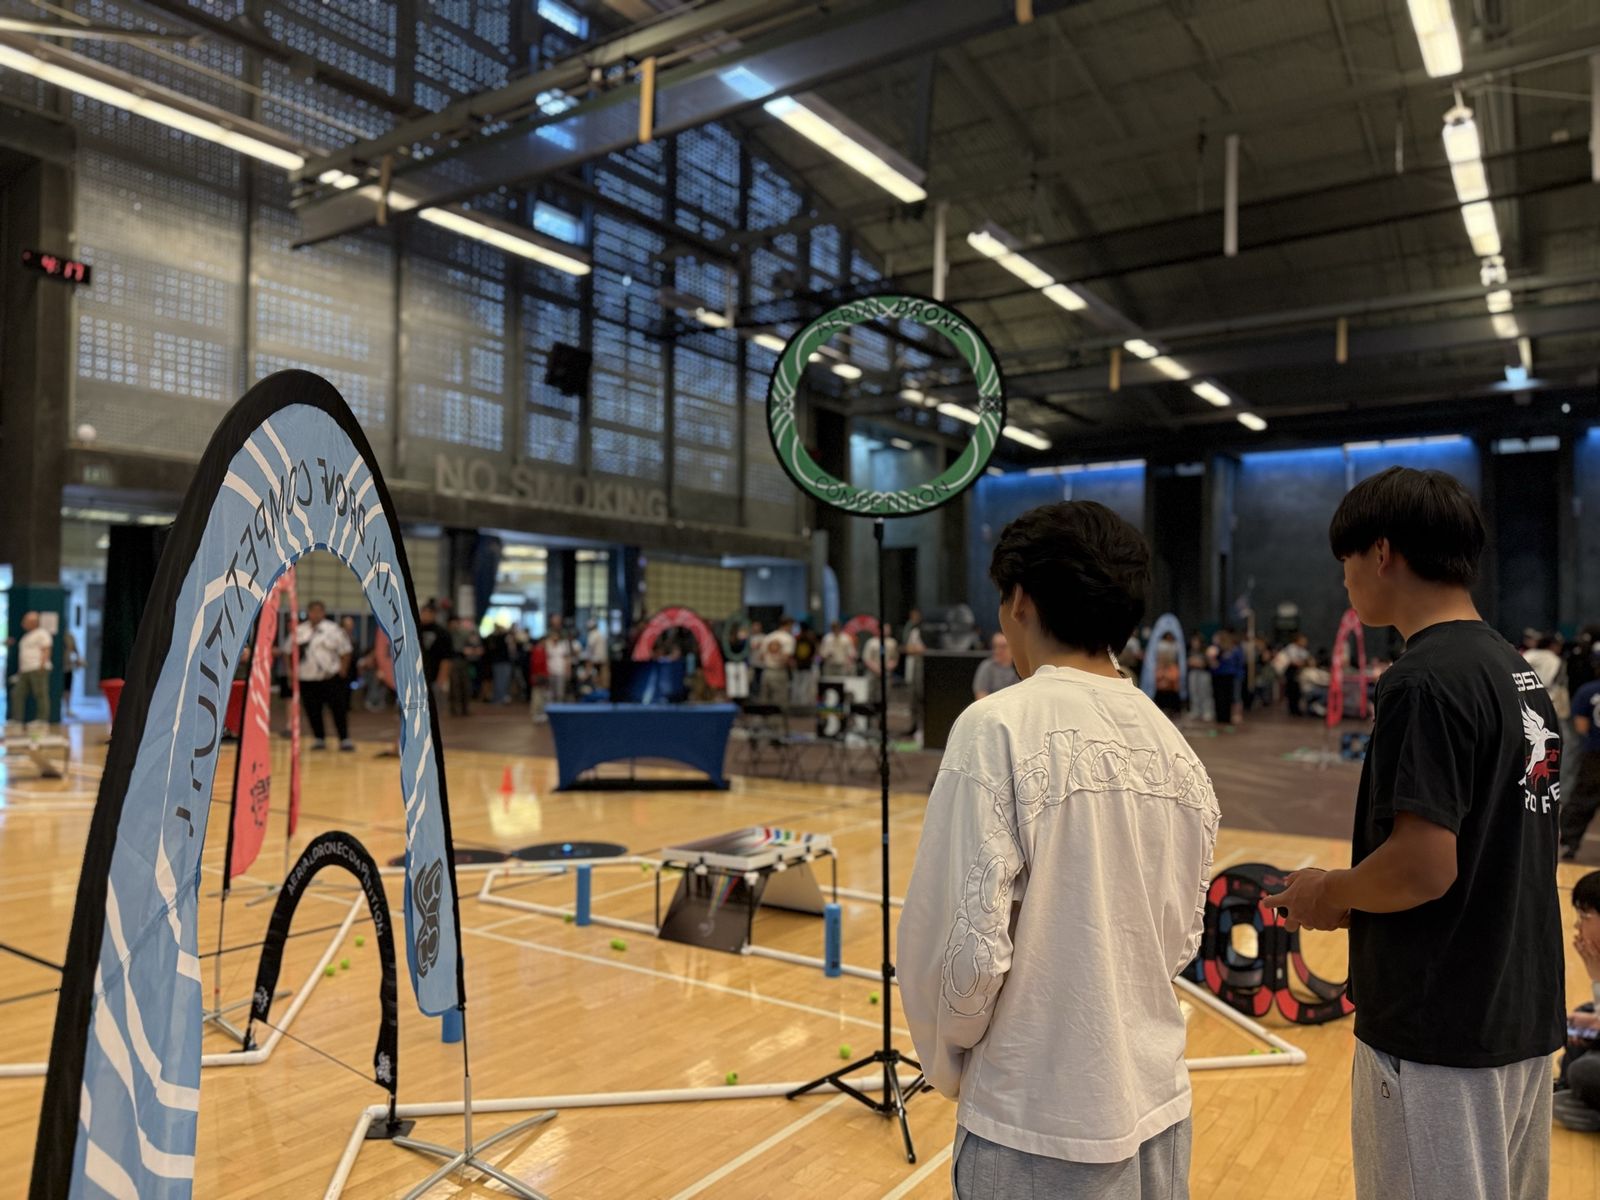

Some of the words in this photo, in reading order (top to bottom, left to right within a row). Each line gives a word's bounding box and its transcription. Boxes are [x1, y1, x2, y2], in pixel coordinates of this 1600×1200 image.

[816, 301, 881, 338] AERIAL
[895, 299, 963, 337] DRONE
[434, 453, 496, 495] NO
[510, 464, 668, 523] SMOKING
[815, 474, 950, 512] COMPETITION
